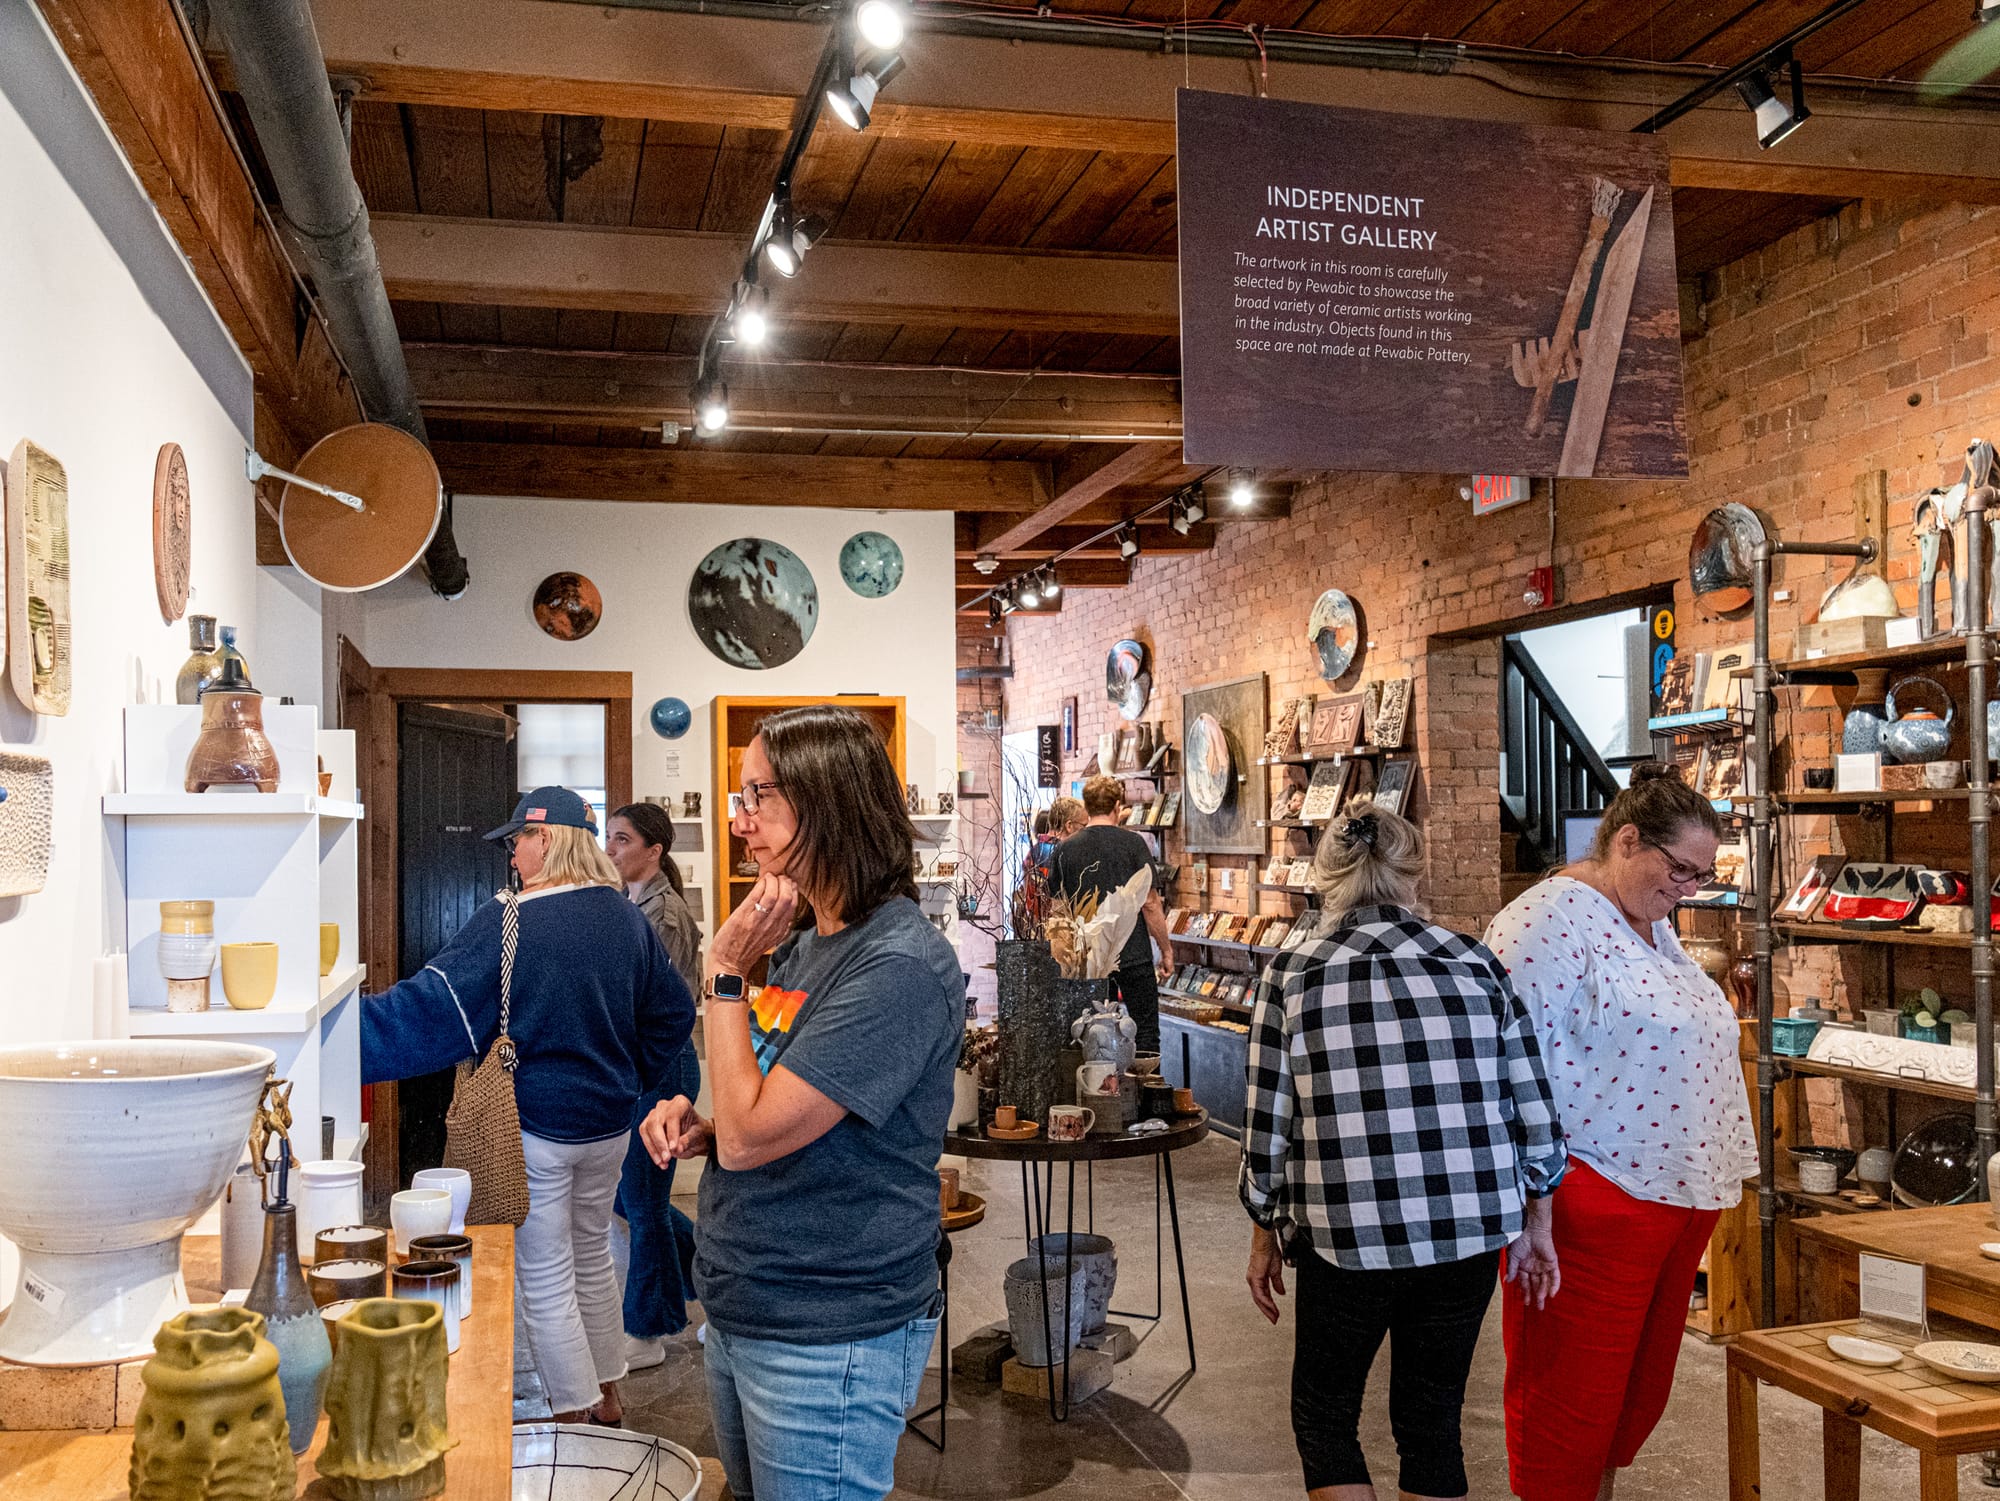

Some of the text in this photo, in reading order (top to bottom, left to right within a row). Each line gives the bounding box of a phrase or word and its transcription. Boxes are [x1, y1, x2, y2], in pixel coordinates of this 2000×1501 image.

[1267, 185, 1425, 218] INDEPENDENT
[1255, 217, 1438, 251] ARTIST GALLERY
[1233, 251, 1449, 284] The artwork in this room is carefully
[1233, 273, 1455, 302] selected by Pewabic to showcase the
[1234, 293, 1472, 326] broad variety of ceramic artists working
[1235, 315, 1453, 342] in the industry. Objects found in this
[1235, 338, 1473, 365] space are not made at Pewabic Pottery.
